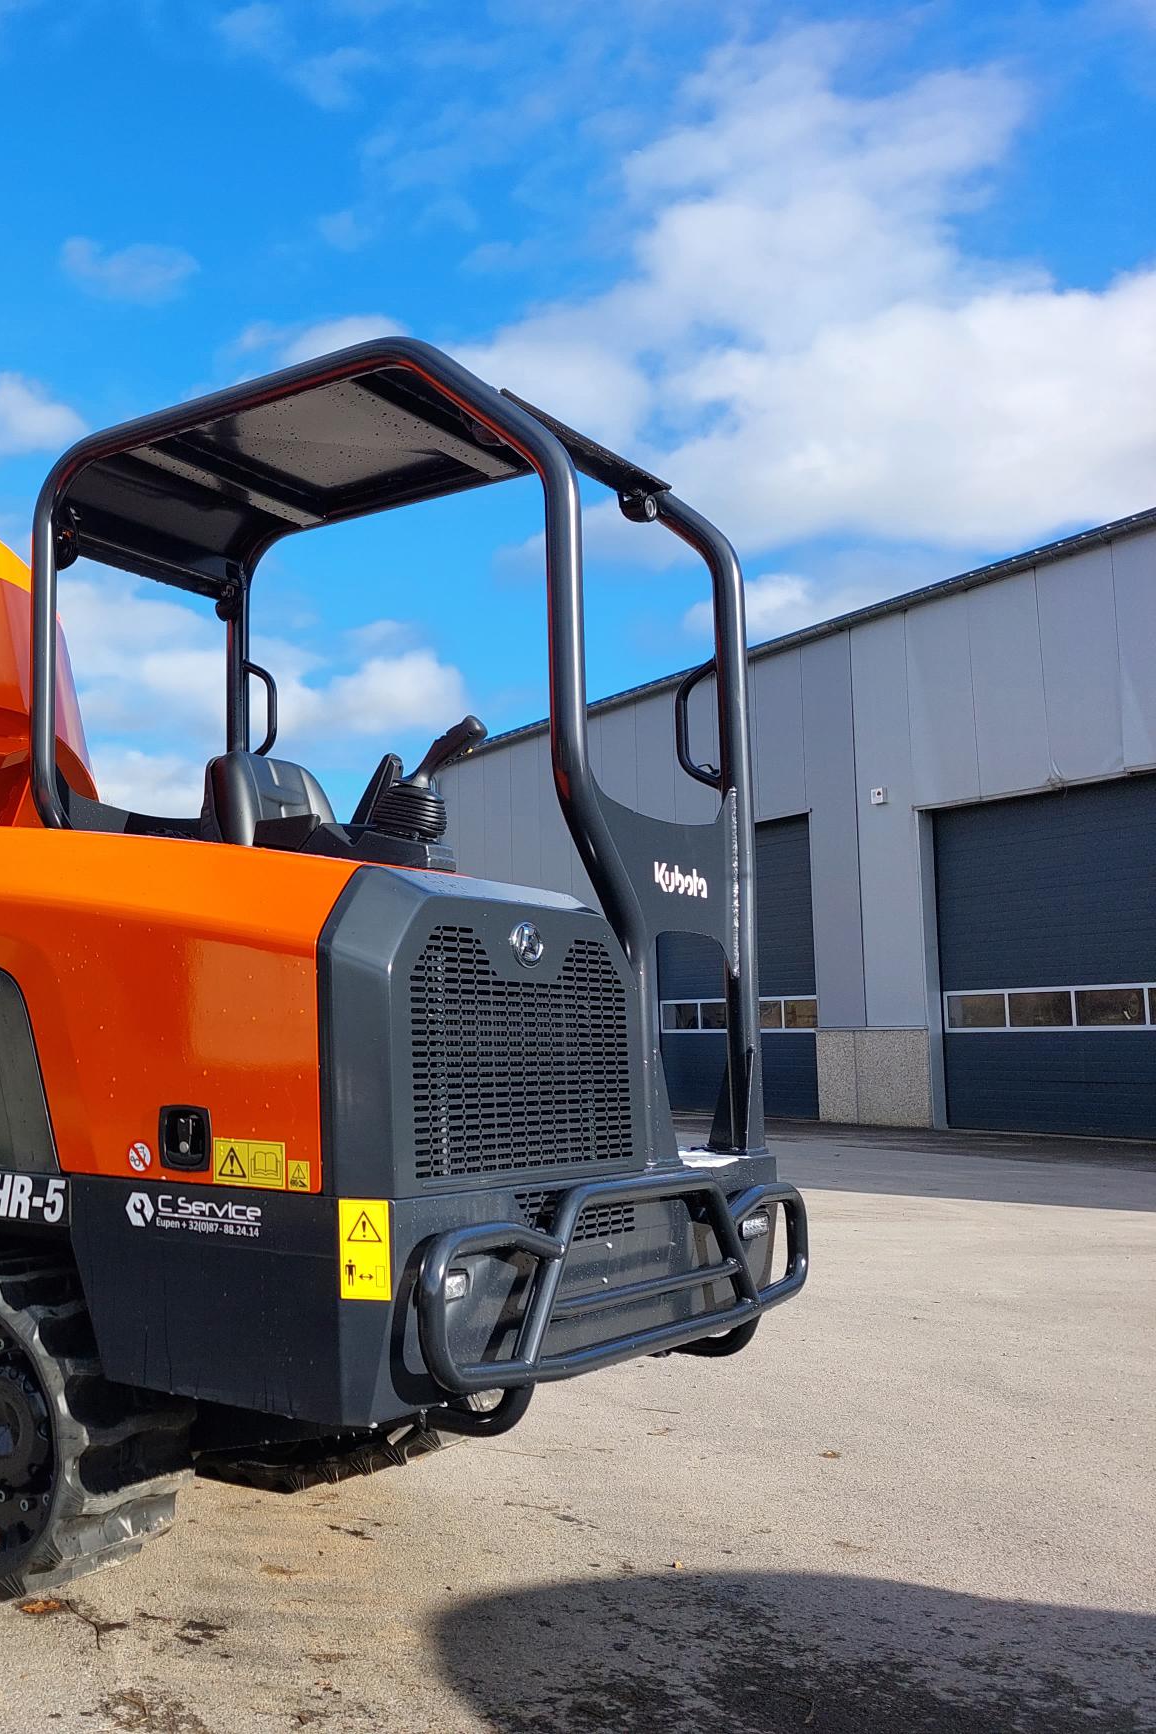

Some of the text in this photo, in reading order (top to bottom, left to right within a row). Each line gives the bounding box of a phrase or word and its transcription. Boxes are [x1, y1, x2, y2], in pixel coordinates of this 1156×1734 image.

[654, 861, 708, 899] Kubota
[157, 1194, 262, 1221] C Service
[155, 1216, 180, 1230] Eupen
